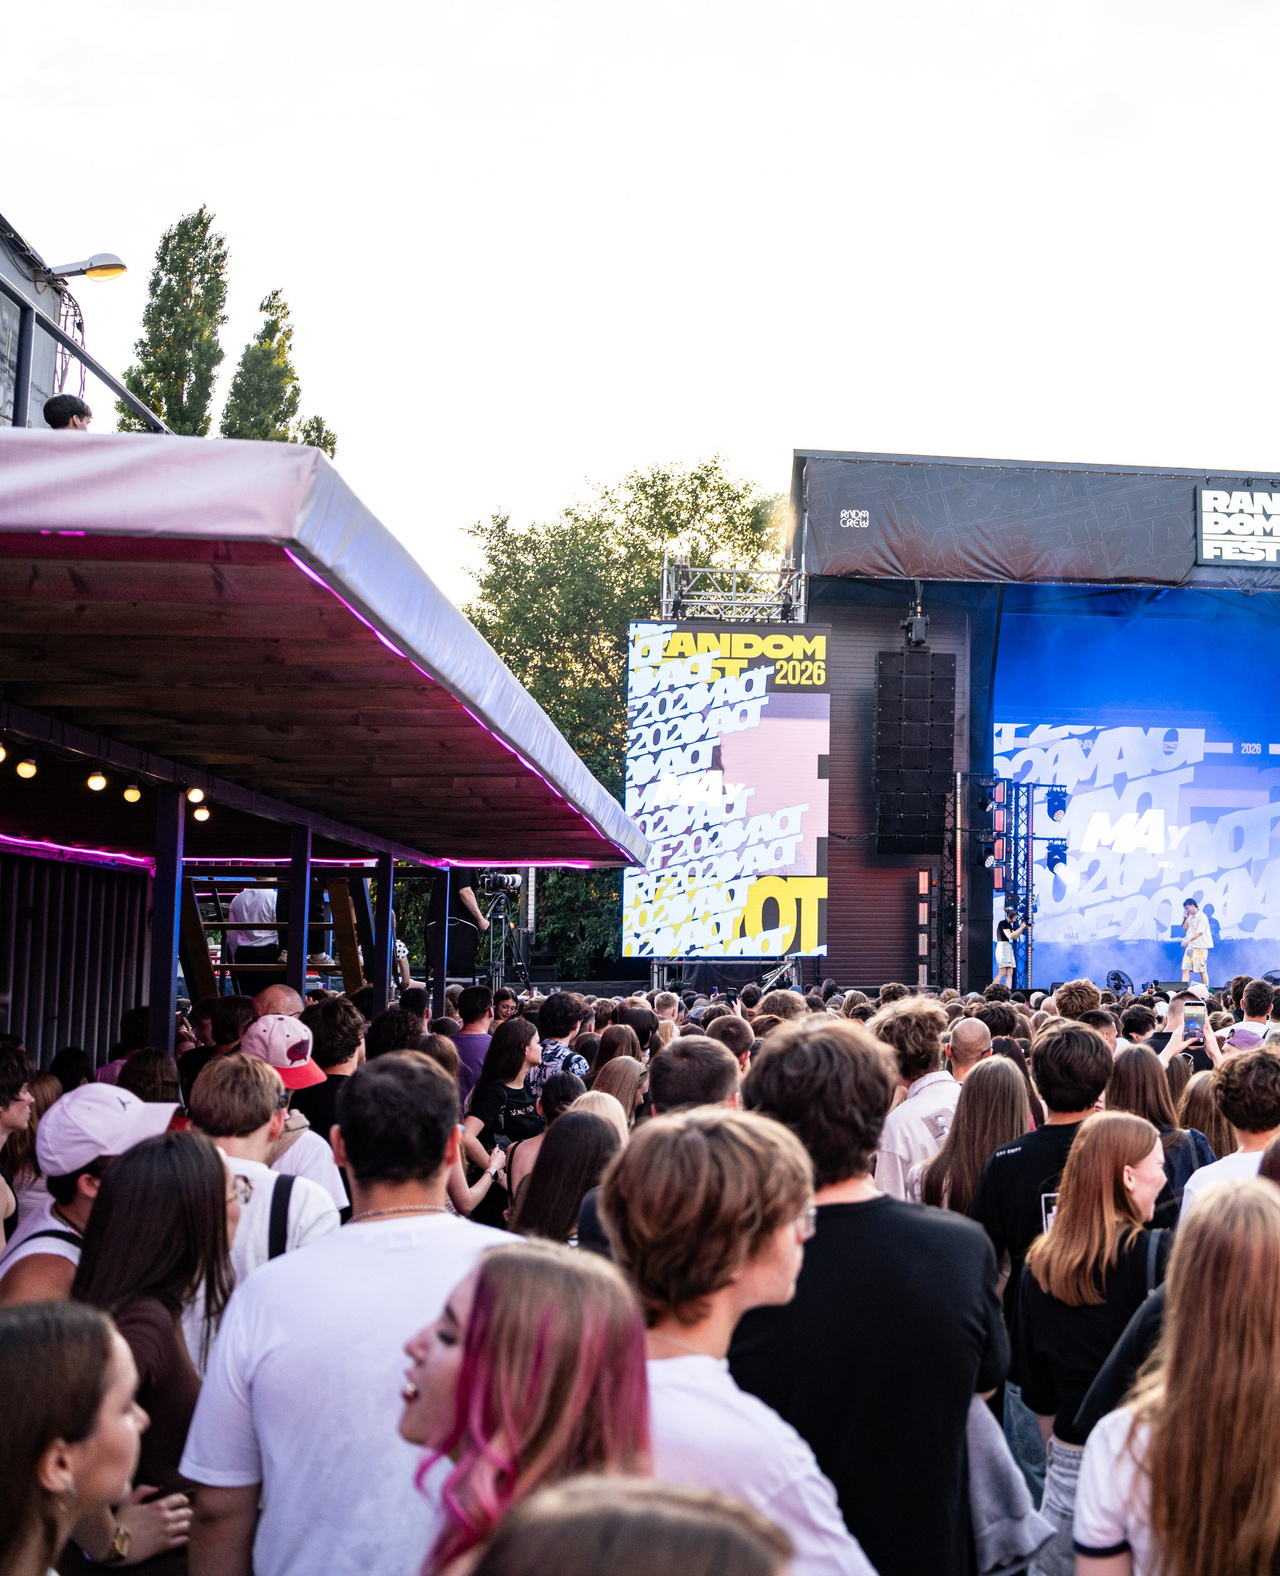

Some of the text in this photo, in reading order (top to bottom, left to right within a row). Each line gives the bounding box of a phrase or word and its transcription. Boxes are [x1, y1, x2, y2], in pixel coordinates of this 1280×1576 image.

[1202, 490, 1280, 515] RAN
[635, 632, 827, 661] ANDOM
[775, 660, 827, 686] 2026
[1241, 743, 1262, 755] 2026
